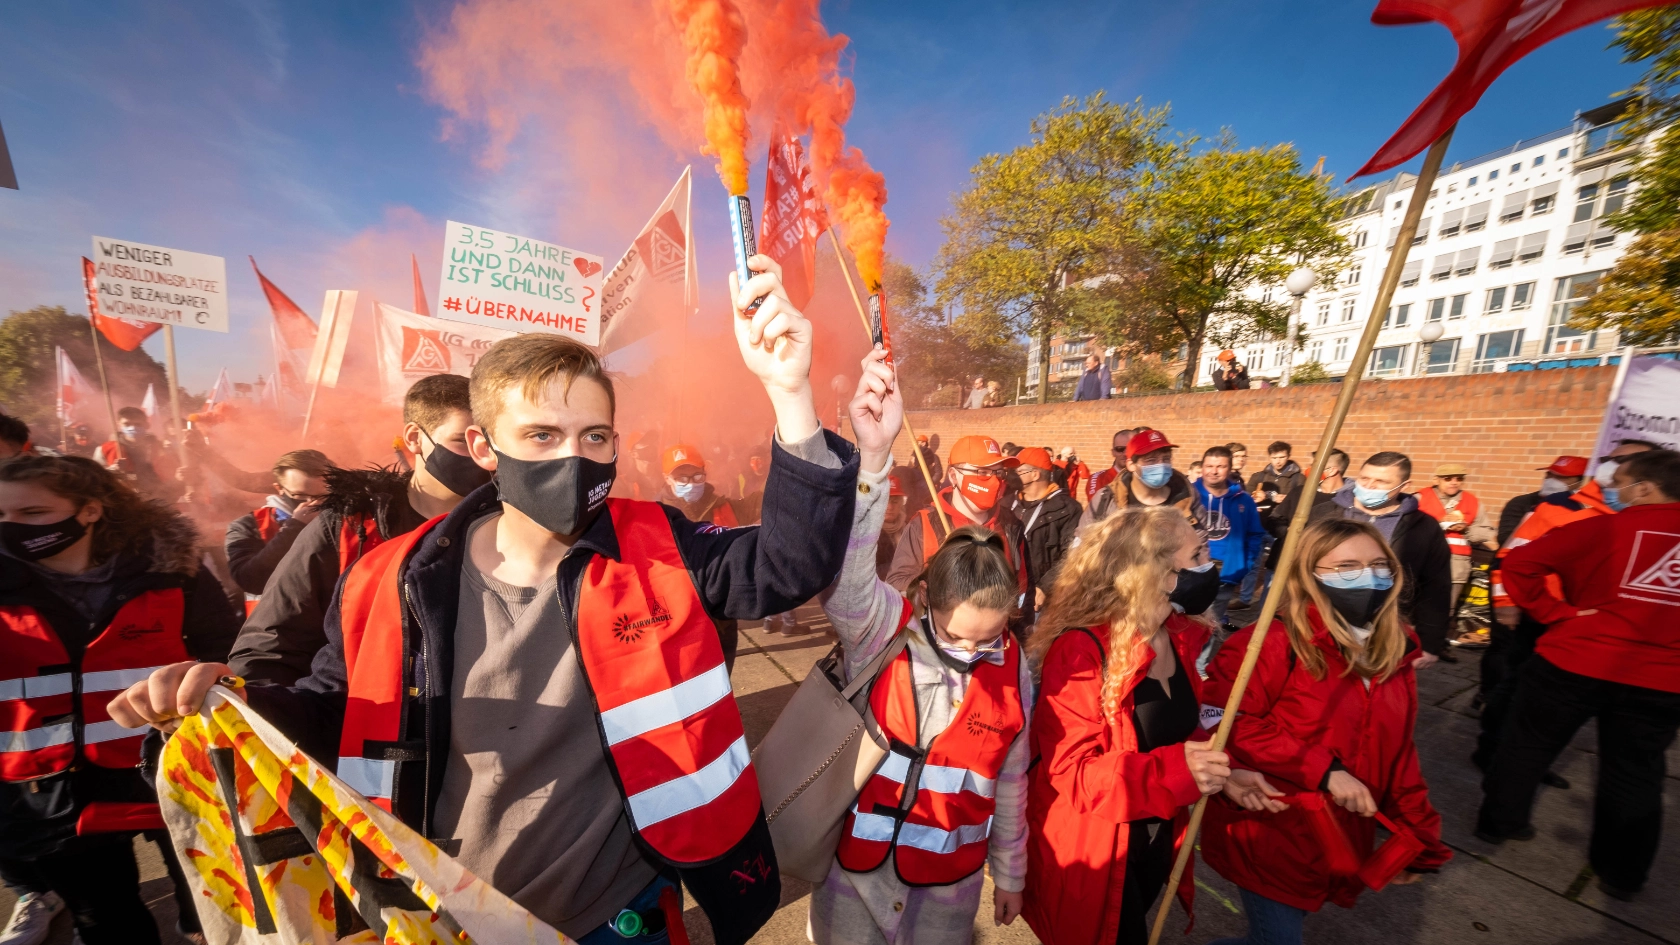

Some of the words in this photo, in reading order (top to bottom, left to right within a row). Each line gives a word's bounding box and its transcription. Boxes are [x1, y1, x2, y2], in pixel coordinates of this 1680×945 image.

[98, 241, 174, 267] WENIGER
[458, 226, 494, 249] 3,5
[504, 236, 572, 266] JAHRE
[451, 247, 502, 269] UND
[509, 257, 565, 283] DANN
[98, 282, 124, 296] ALS
[130, 286, 209, 309] BEZAHLBARER
[447, 265, 484, 284] IST
[490, 272, 576, 304] SCHLUSS
[582, 286, 595, 312] ?
[102, 298, 182, 322] WOHNRAUM!
[443, 296, 588, 334] #ÜBERNAHME
[623, 614, 673, 631] #FAIRWANDEL
